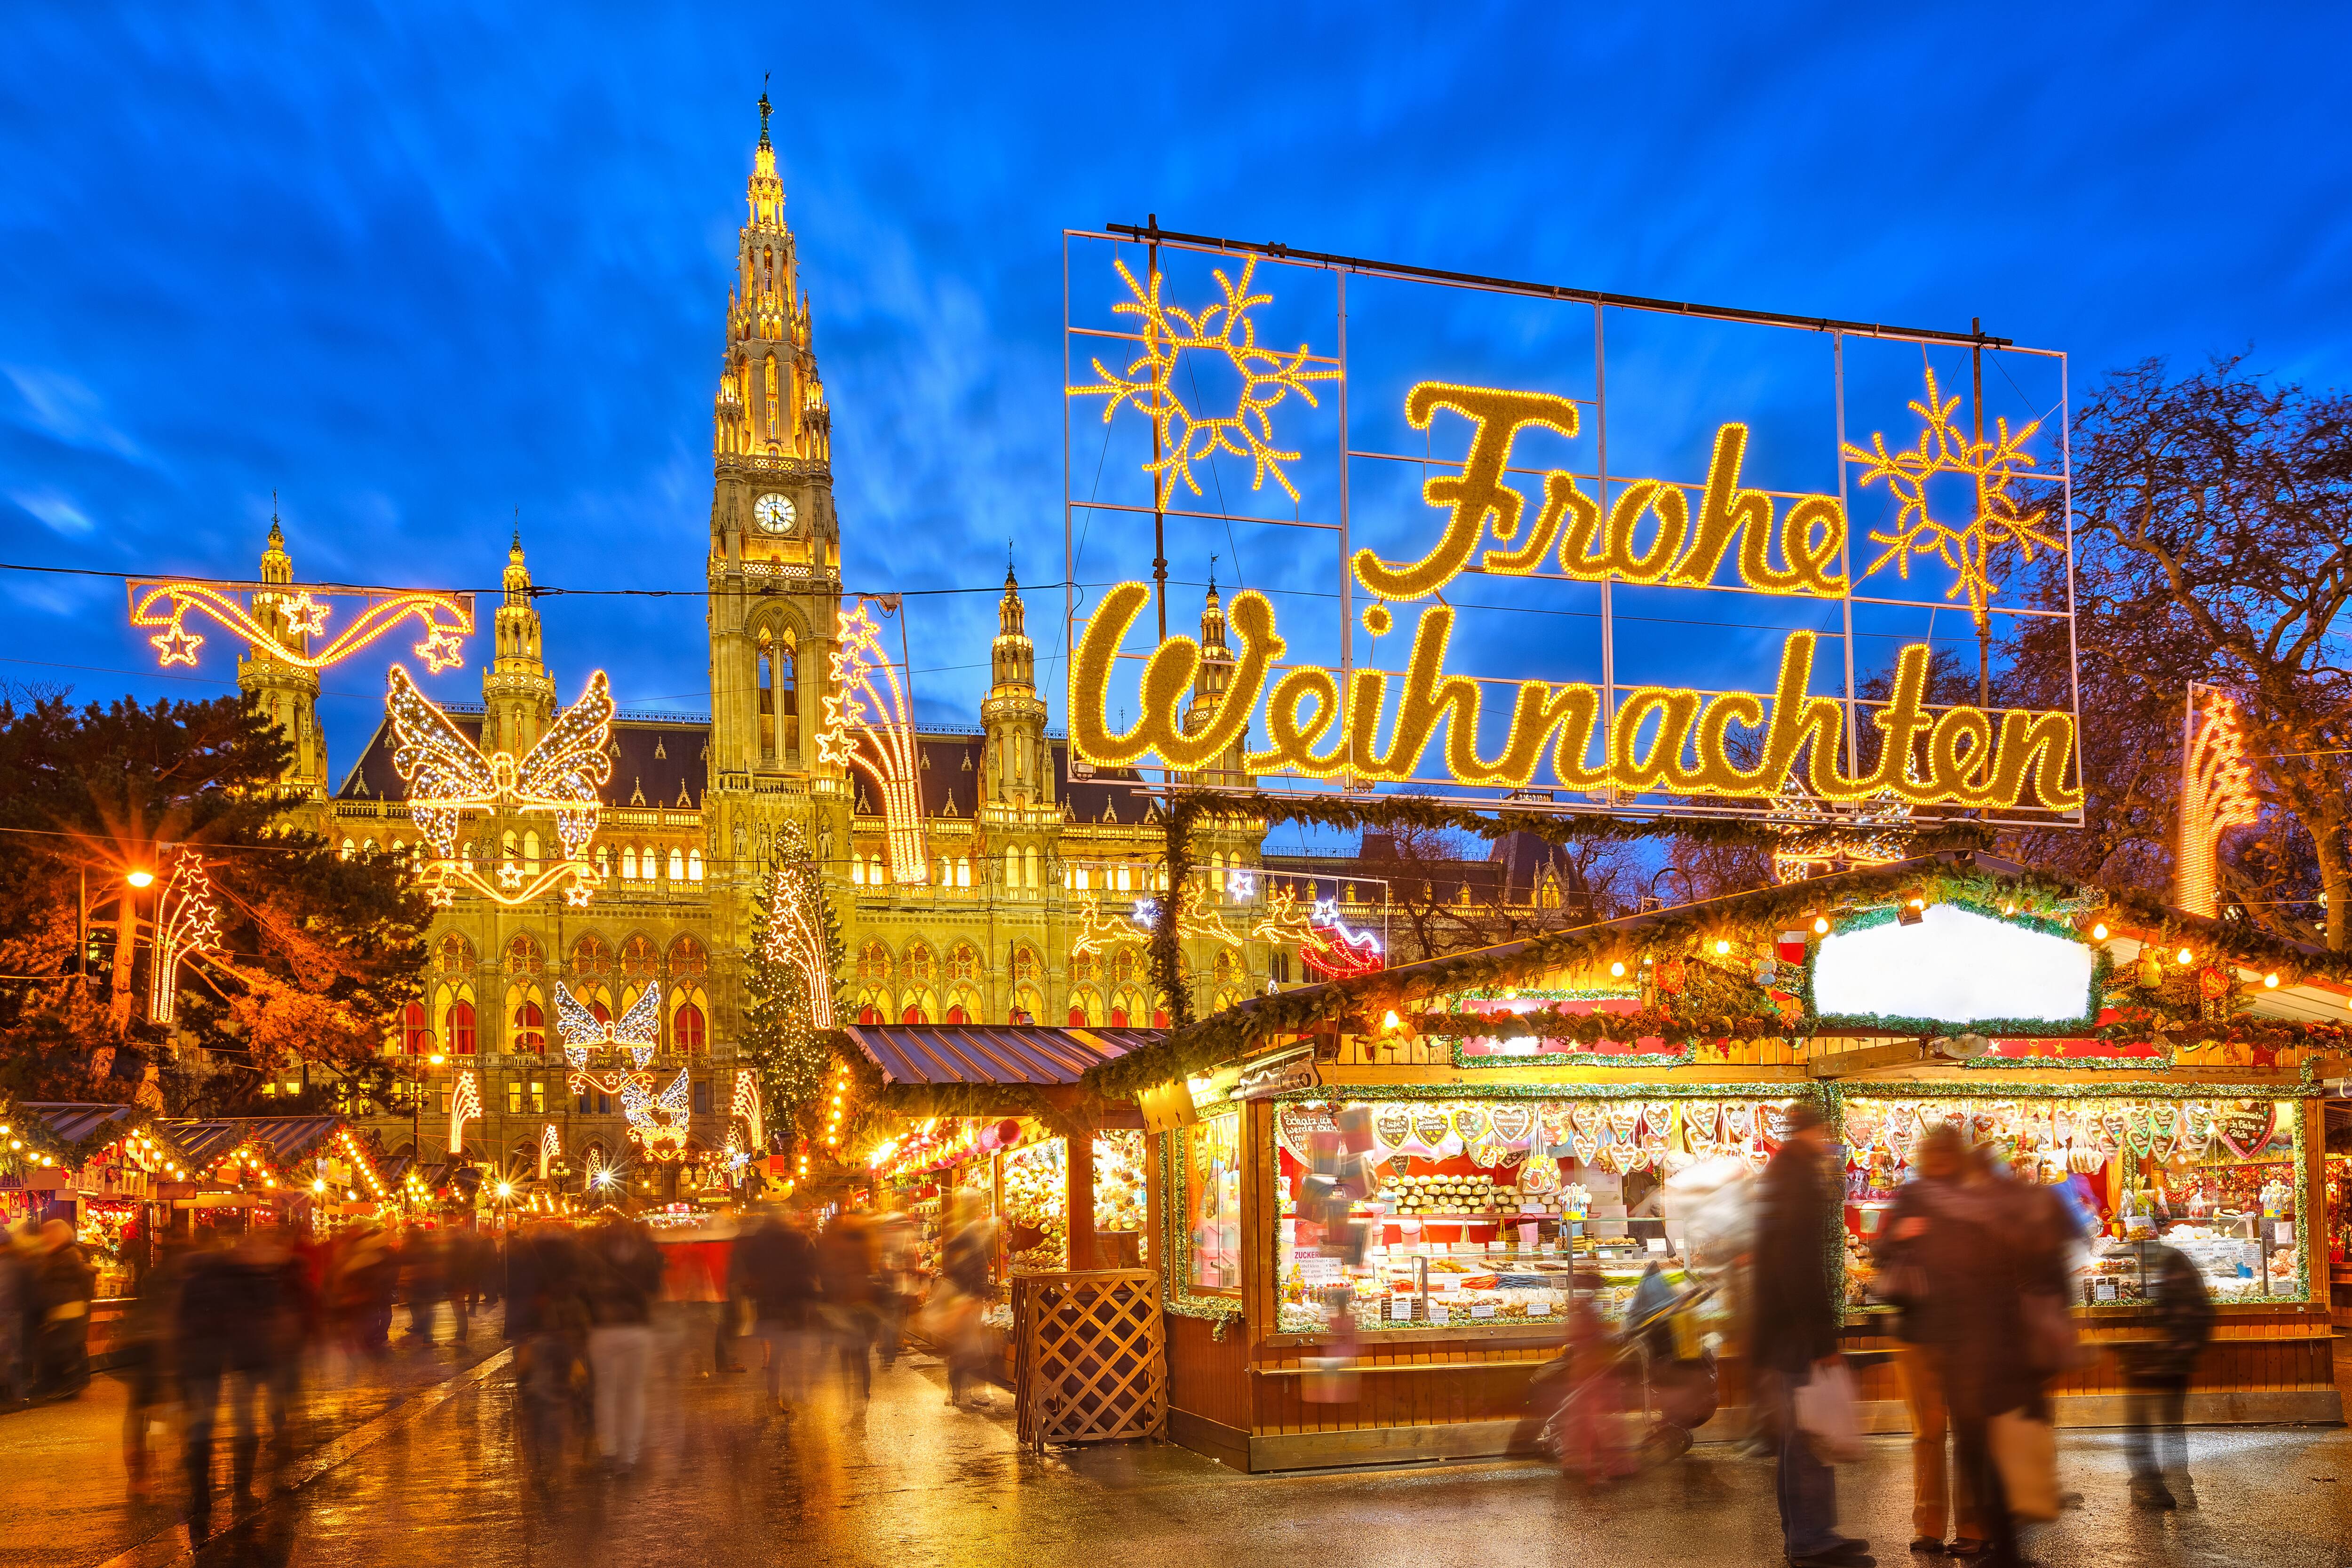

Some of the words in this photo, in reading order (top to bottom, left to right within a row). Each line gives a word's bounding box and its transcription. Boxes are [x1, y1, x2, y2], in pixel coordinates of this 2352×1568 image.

[1351, 381, 1849, 601] Frohe
[1068, 581, 2084, 809] Weihnachten
[1286, 1125, 1313, 1134] werde
[2238, 1120, 2257, 1131] liebe
[2228, 1129, 2249, 1138] Dich
